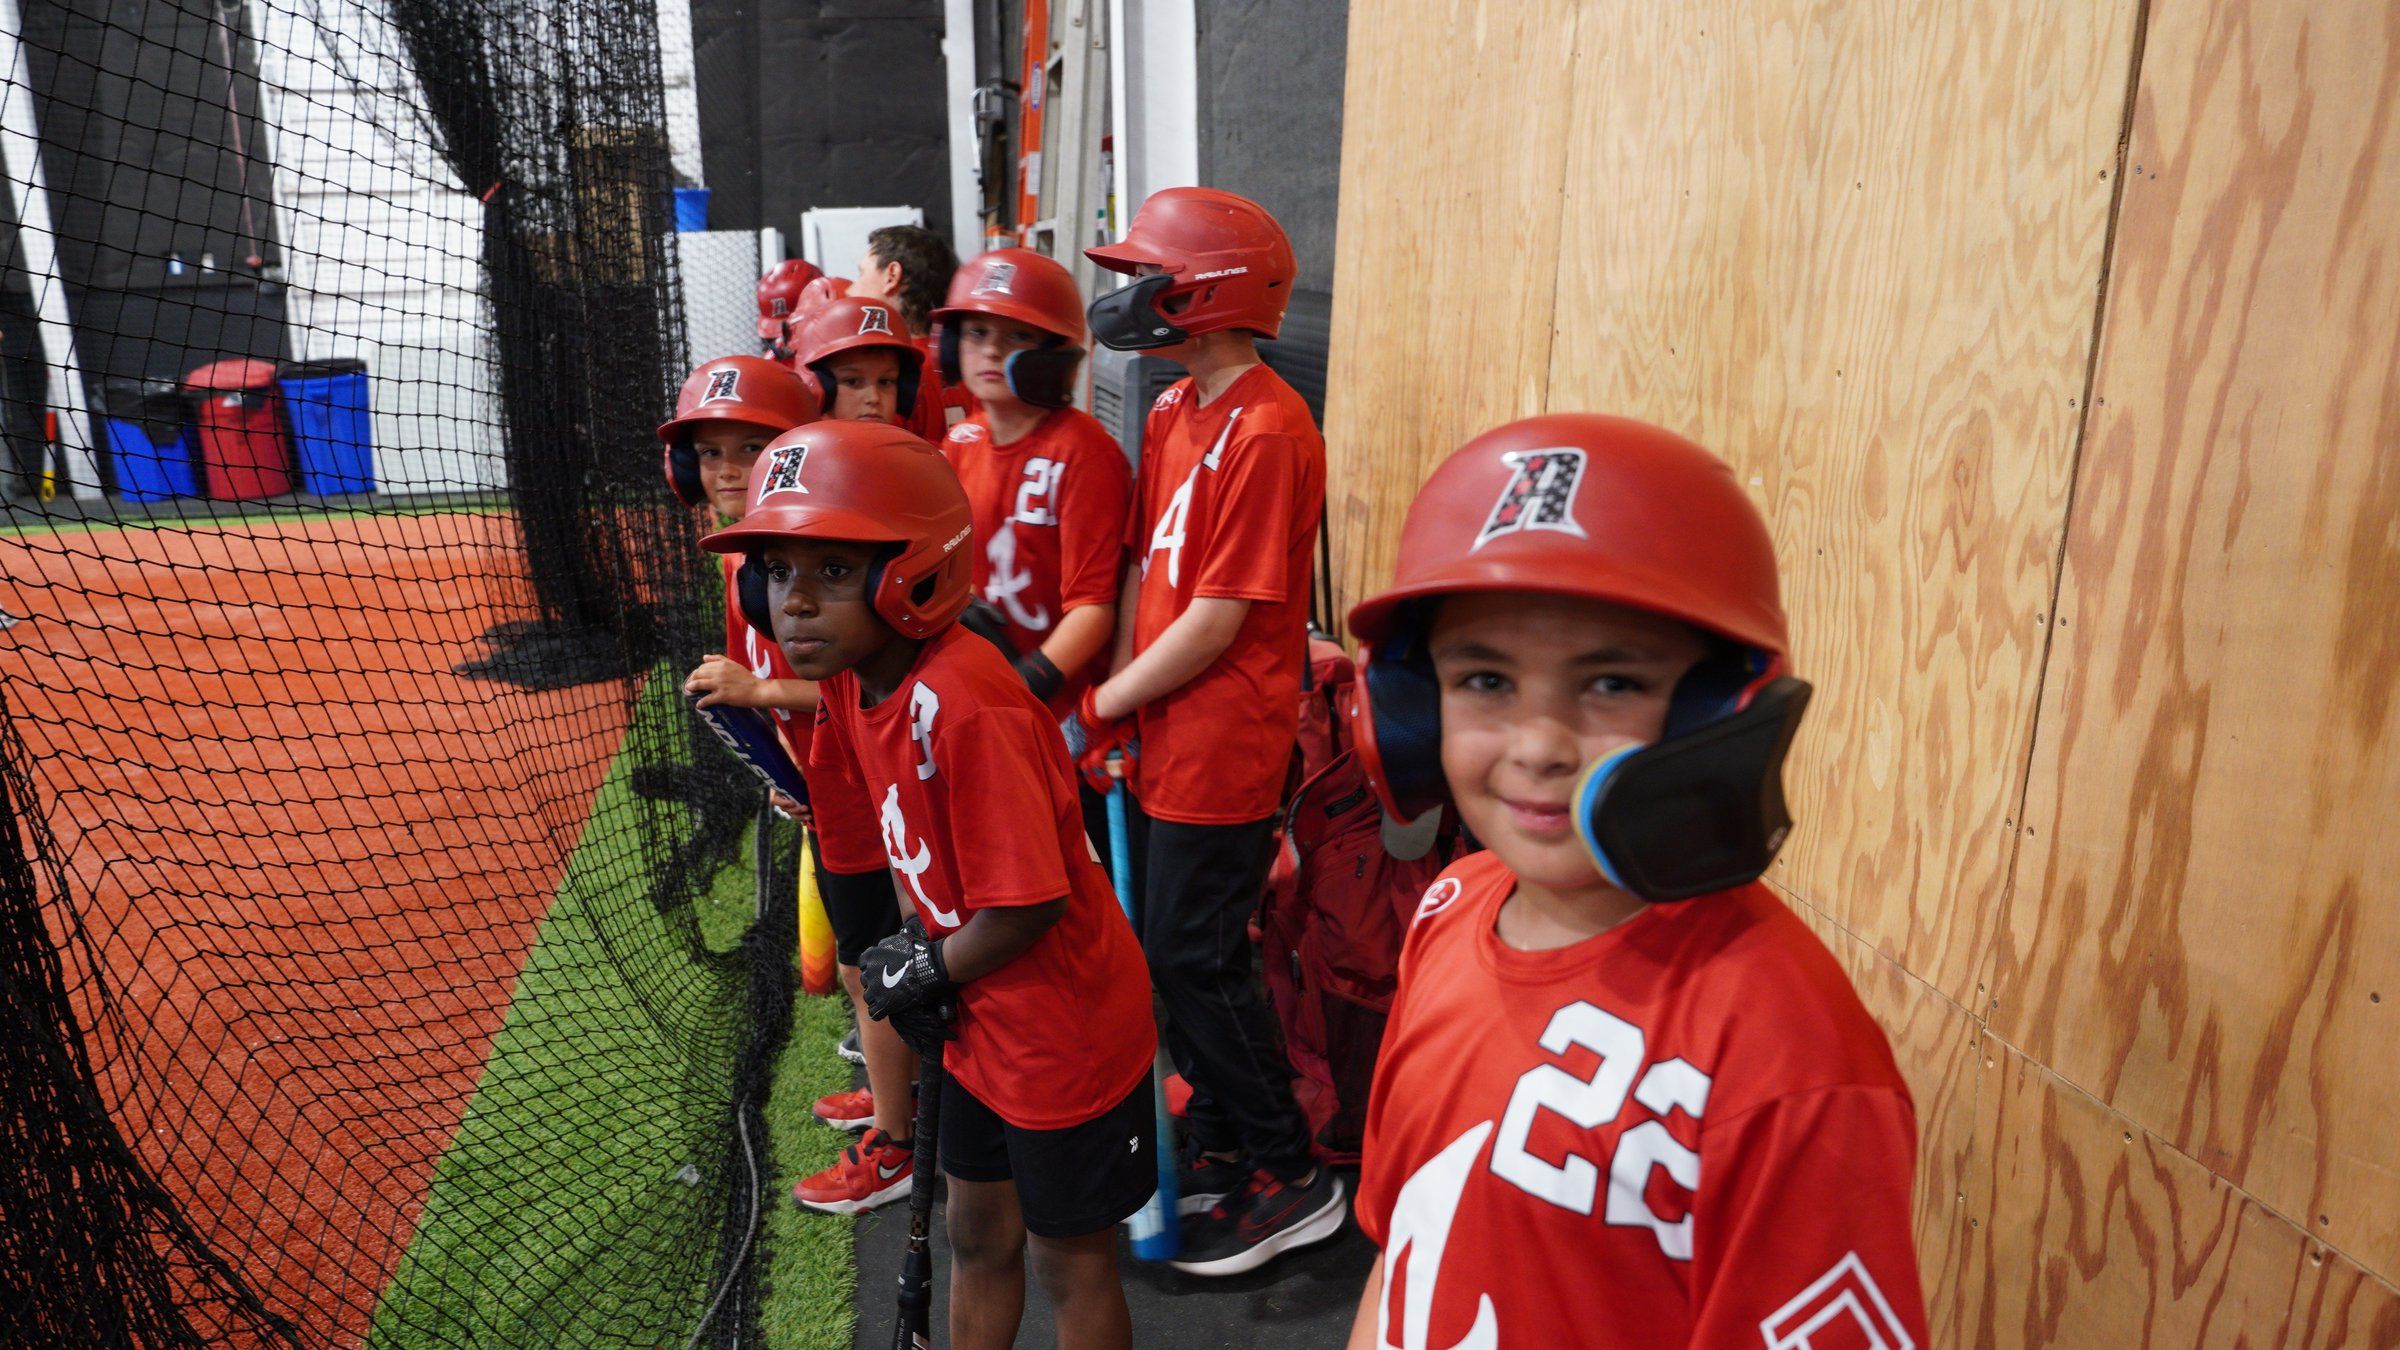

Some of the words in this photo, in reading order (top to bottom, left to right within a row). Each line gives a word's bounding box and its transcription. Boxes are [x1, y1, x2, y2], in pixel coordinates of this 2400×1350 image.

[756, 443, 810, 506] A
[1202, 406, 1244, 472] 1
[1013, 456, 1066, 526] 21
[1469, 446, 1589, 554] A
[909, 679, 940, 781] 3
[1489, 1000, 1712, 1261] 22
